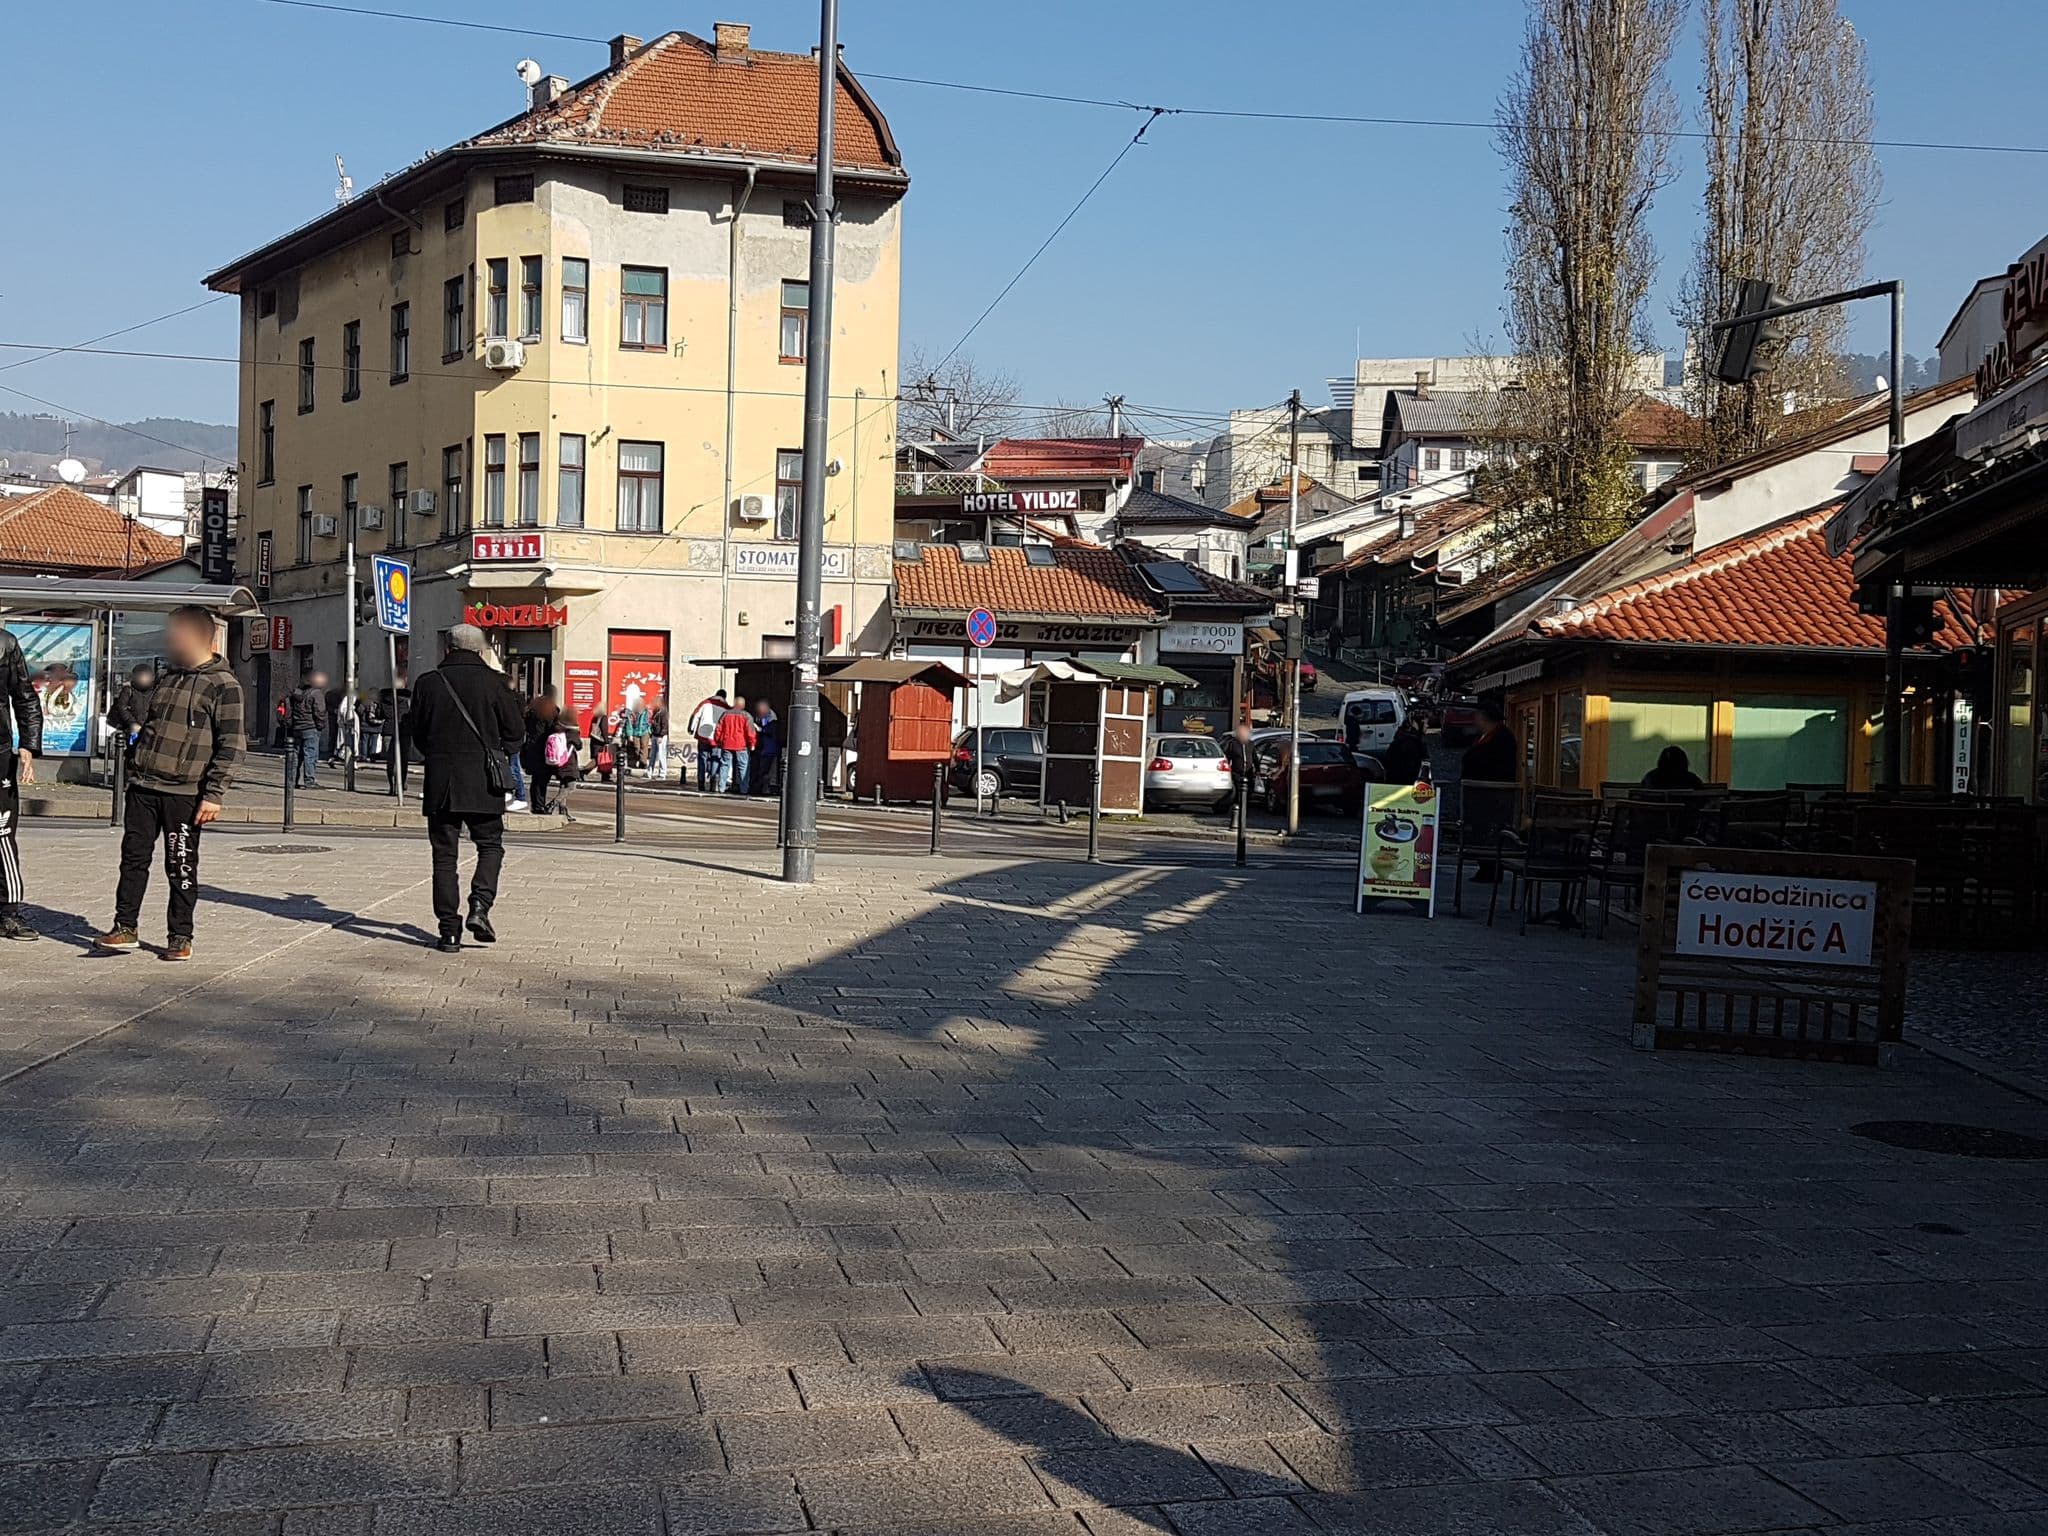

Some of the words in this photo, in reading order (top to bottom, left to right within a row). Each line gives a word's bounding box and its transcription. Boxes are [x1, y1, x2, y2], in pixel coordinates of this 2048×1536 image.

[964, 493, 1017, 511] HOTEL
[1022, 491, 1077, 510] YILDIZ
[207, 499, 225, 573] HOTEL
[478, 543, 537, 557] SEBIL
[739, 550, 839, 568] STOMATOG
[464, 604, 568, 628] KONZUM
[1202, 626, 1237, 637] FOOD
[1687, 878, 1867, 910] ćevabdžinica
[1699, 913, 1816, 952] Hodžić
[1822, 921, 1848, 954] A
